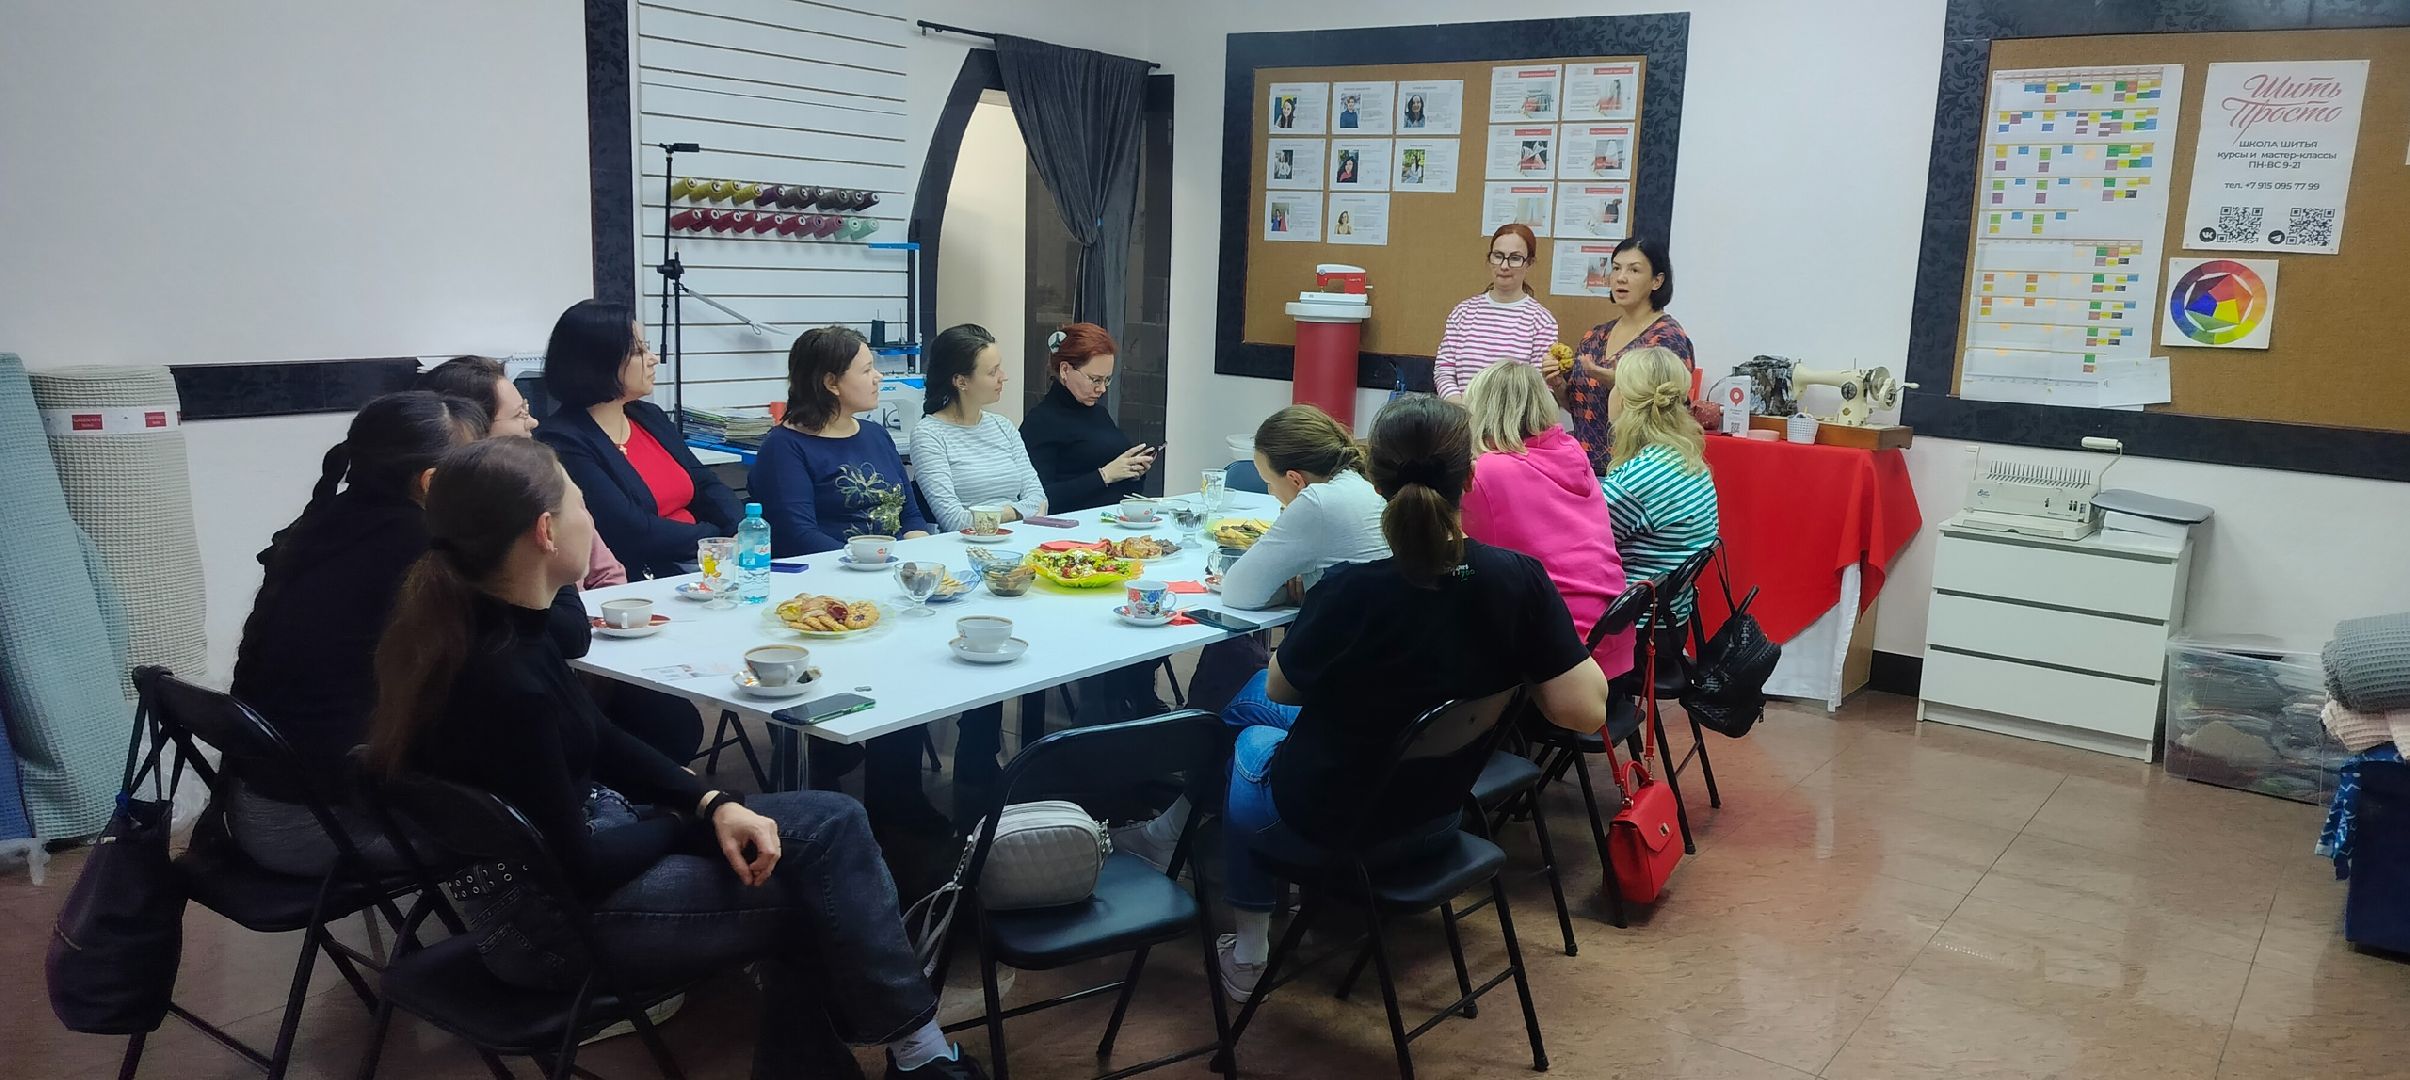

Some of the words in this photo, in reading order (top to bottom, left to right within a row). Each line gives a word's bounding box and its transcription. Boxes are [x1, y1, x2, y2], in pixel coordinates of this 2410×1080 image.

[2243, 74, 2342, 99] Шить
[2221, 97, 2343, 146] Просто
[2260, 152, 2337, 160] мастер-классы
[2248, 161, 2281, 169] ПН-ВС
[2282, 161, 2301, 169] 9-21
[2224, 182, 2243, 190] тел.
[2245, 182, 2256, 190] +7
[2257, 182, 2272, 190] 915
[2274, 182, 2292, 190] 095
[2294, 182, 2306, 190] 77
[2307, 183, 2320, 191] 99
